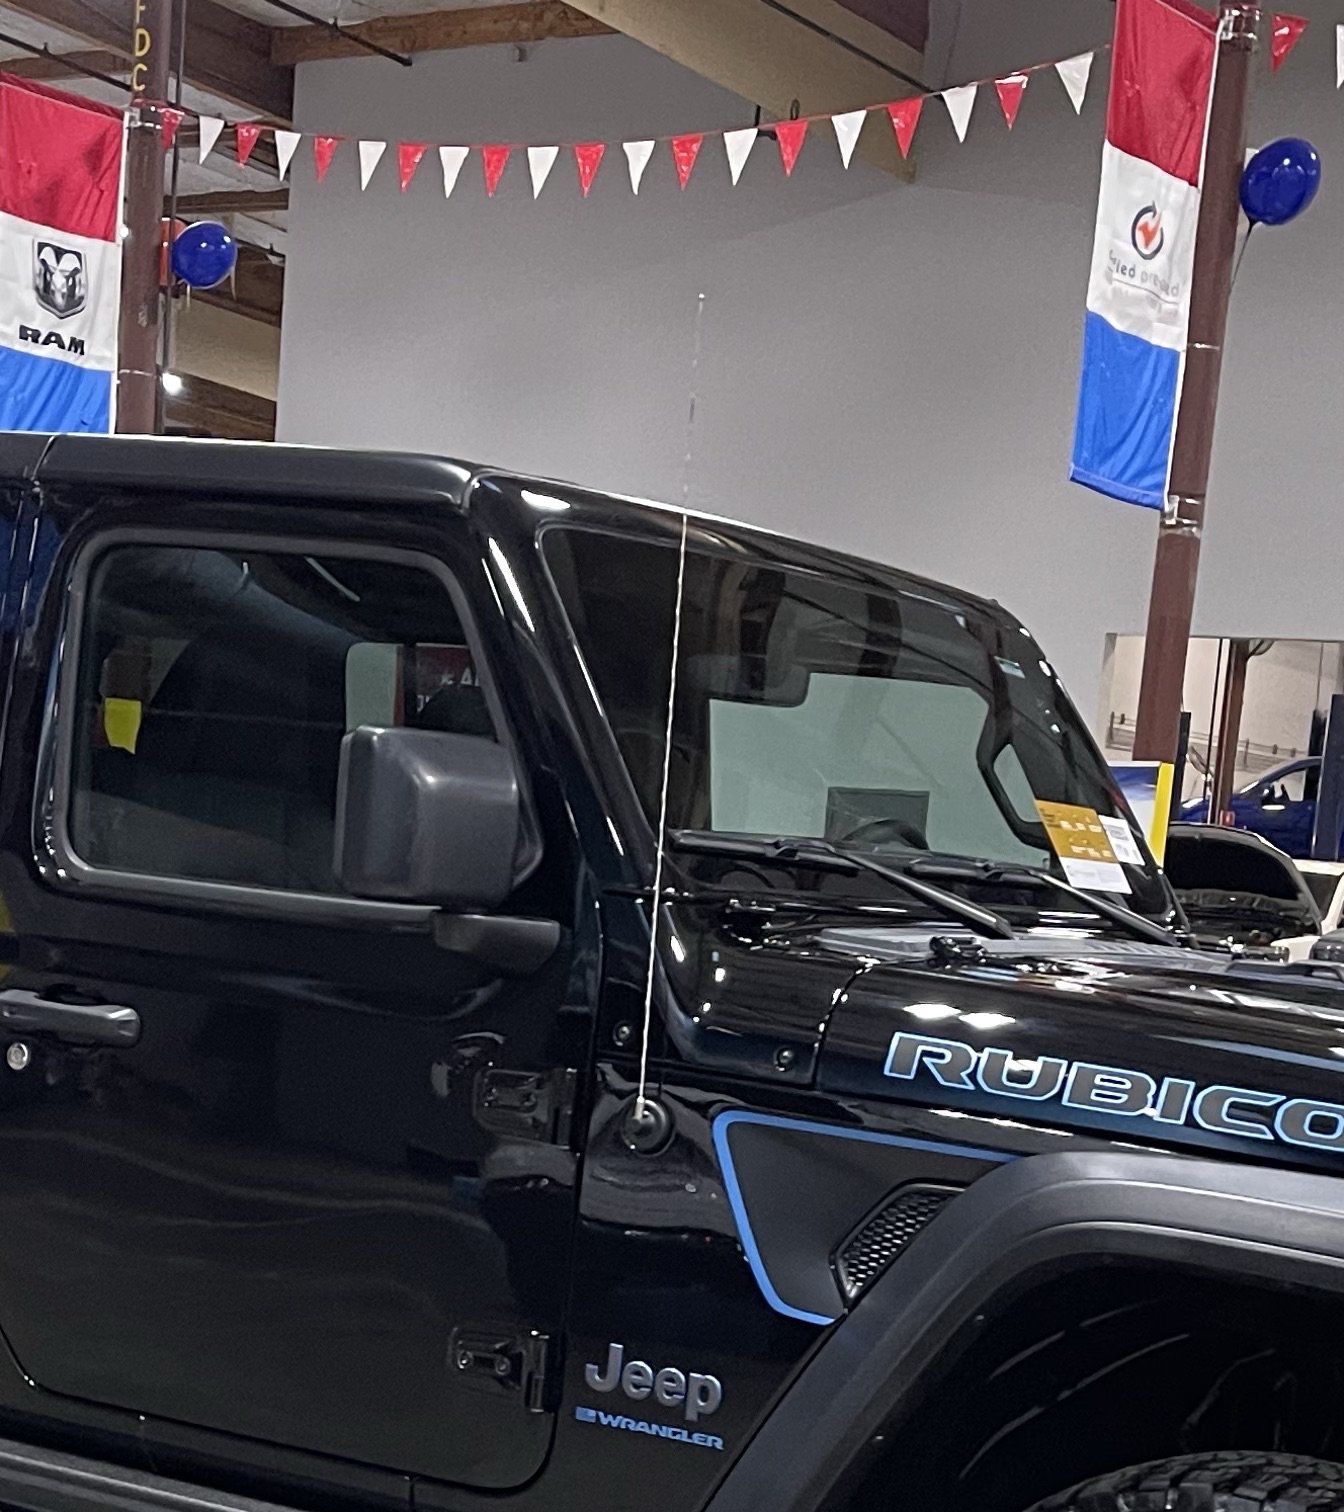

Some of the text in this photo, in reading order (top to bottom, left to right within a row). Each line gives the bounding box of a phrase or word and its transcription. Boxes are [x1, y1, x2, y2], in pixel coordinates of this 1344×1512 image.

[18, 324, 86, 357] RAM
[584, 1342, 723, 1422] Jeep
[596, 1410, 724, 1450] WRANGLER
